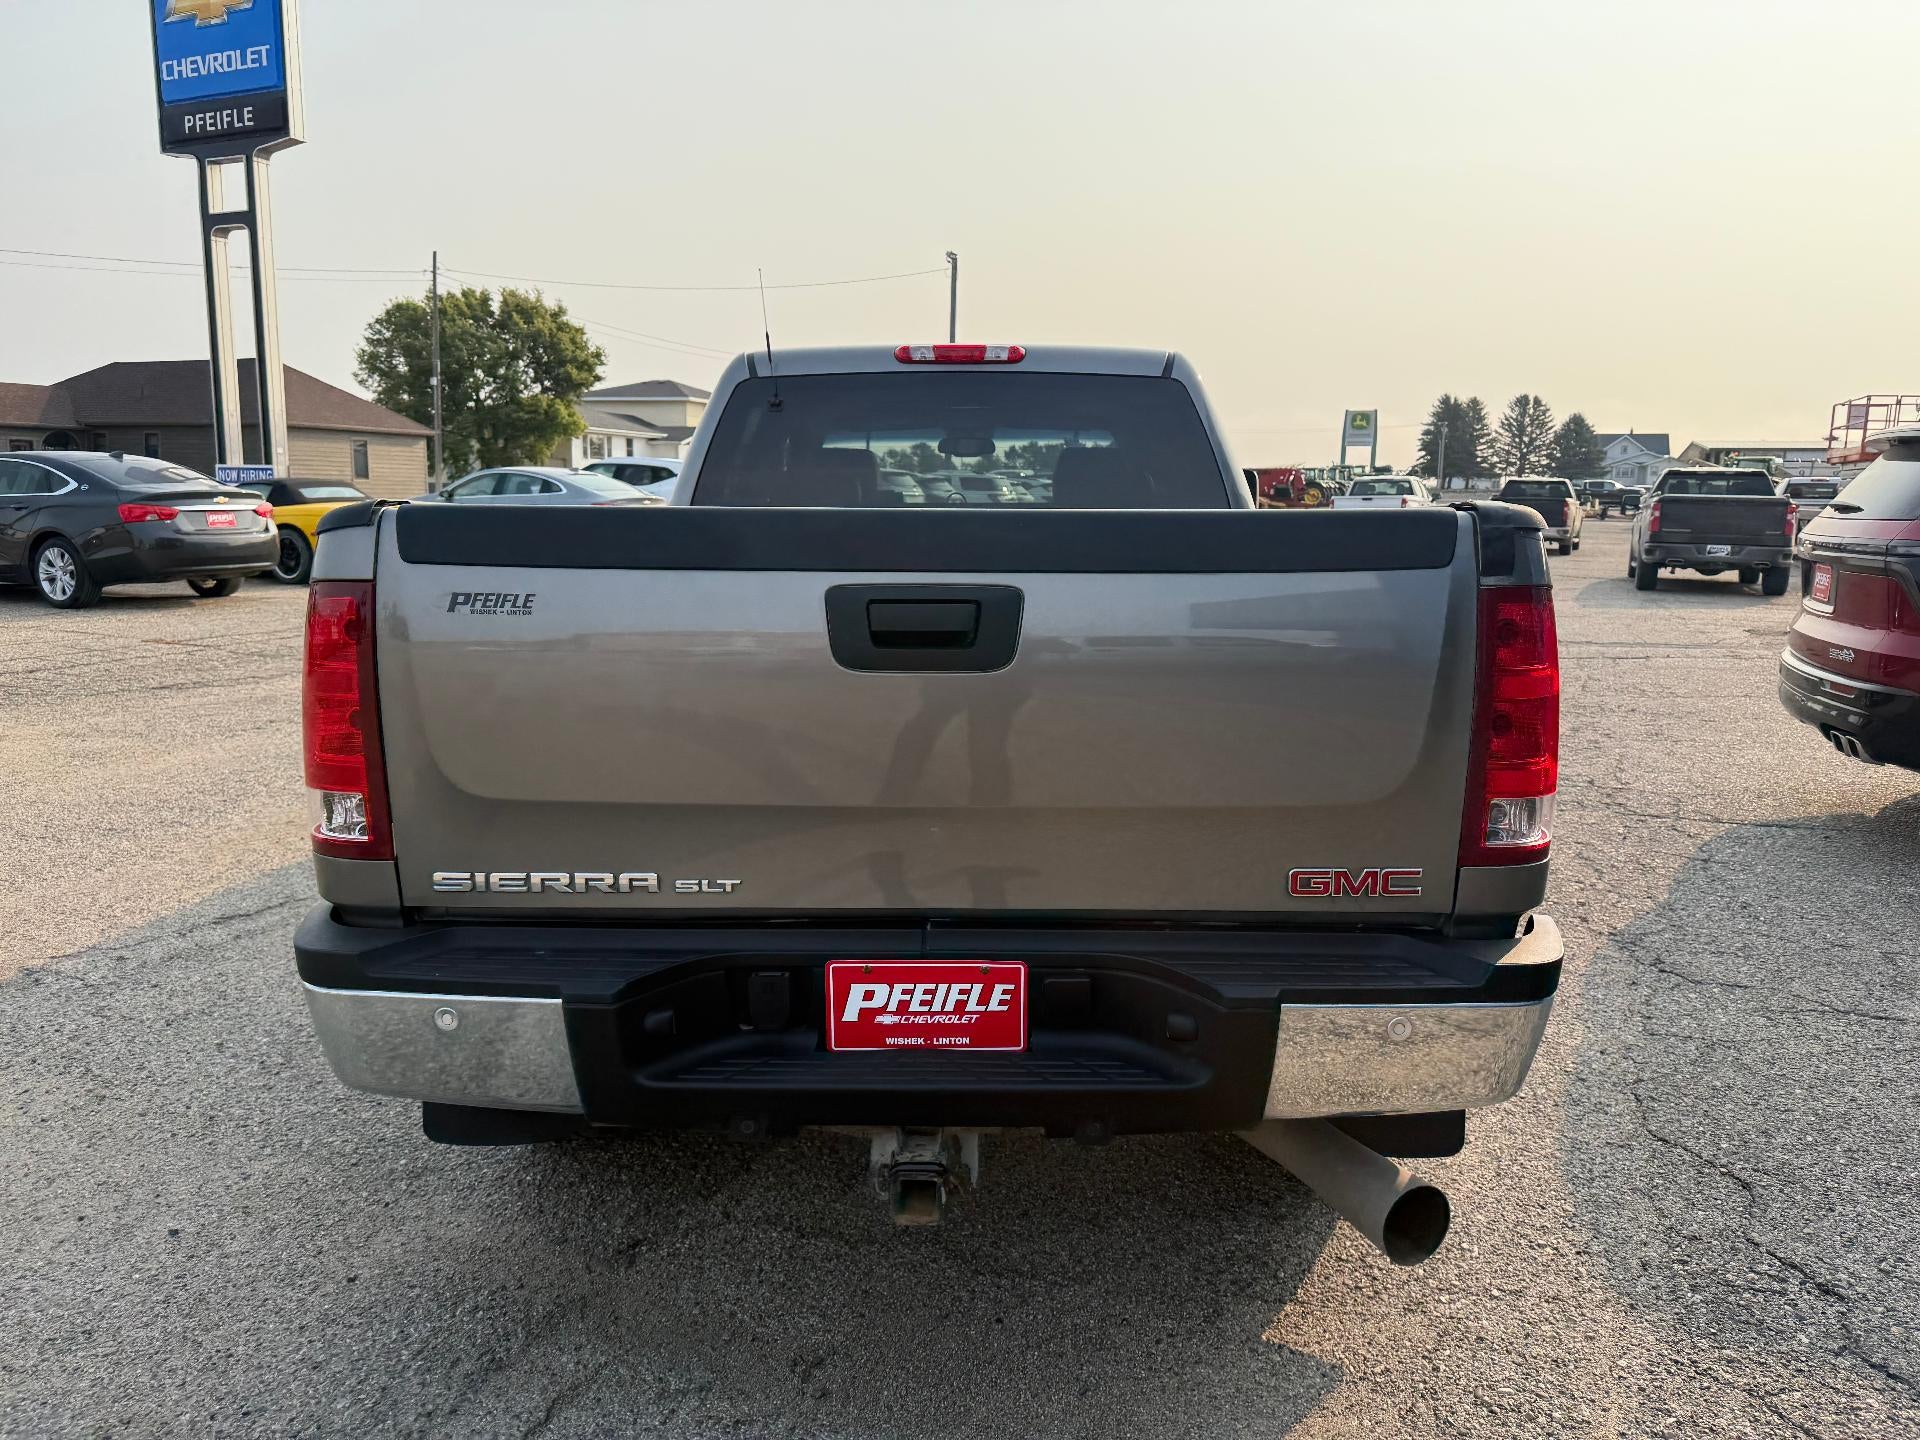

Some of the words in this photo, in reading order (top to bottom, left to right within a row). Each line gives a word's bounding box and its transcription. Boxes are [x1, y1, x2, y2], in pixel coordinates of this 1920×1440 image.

[161, 44, 270, 81] CHEVROLET
[184, 106, 254, 134] PFEIFLE
[218, 469, 238, 481] NOW
[239, 470, 273, 481] HIRING
[446, 592, 536, 612] PFEIFLE
[432, 871, 661, 893] SIERRA
[674, 879, 742, 893] SLT
[1288, 868, 1423, 897] GMC
[841, 983, 1016, 1022] PFEIFLE
[900, 1014, 980, 1024] CHEVROLET
[885, 1037, 925, 1045] WISHEK
[933, 1037, 970, 1045] LINTON
